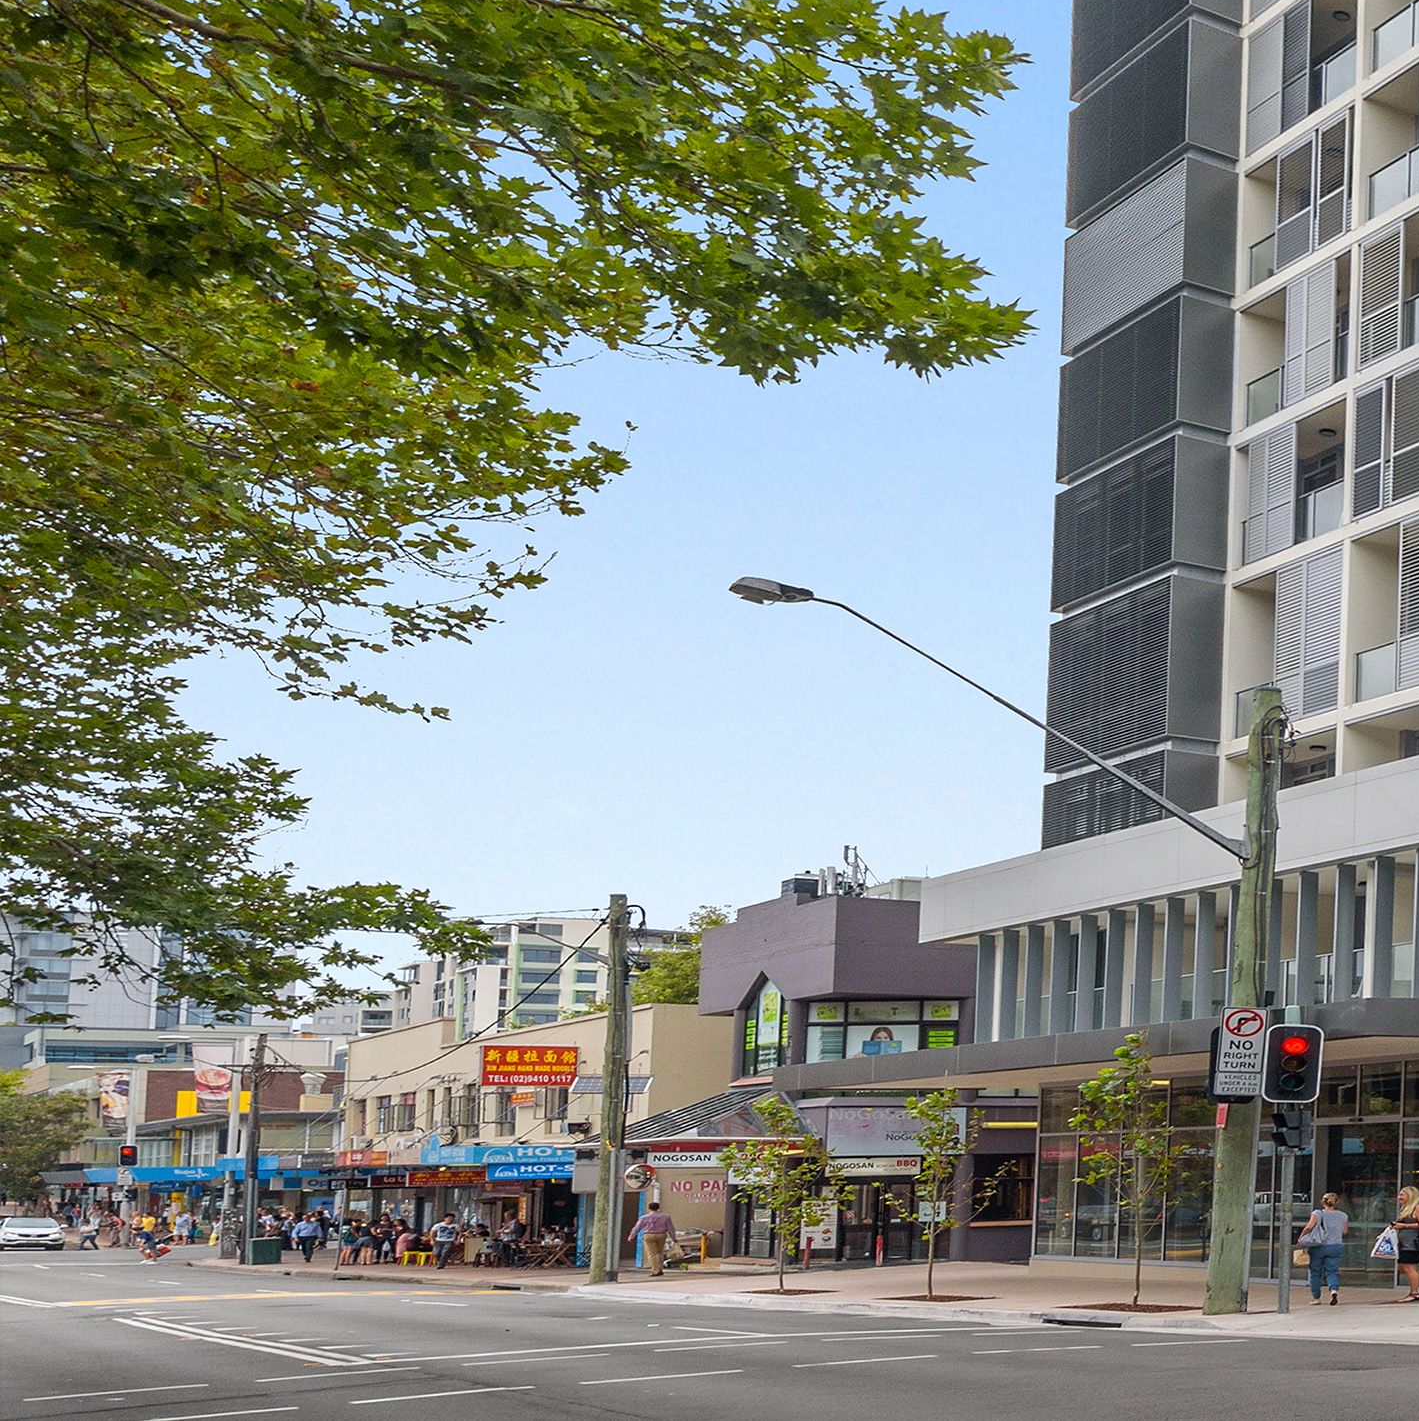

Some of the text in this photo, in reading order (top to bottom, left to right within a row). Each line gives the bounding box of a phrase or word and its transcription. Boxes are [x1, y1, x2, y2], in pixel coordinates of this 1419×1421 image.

[1229, 1040, 1254, 1050] NO
[1223, 1061, 1256, 1069] TURN
[653, 1154, 712, 1162] NOGOSAN
[828, 1162, 874, 1170] NOGOSAN
[896, 1159, 918, 1167] BBQ
[670, 1181, 693, 1192] NO
